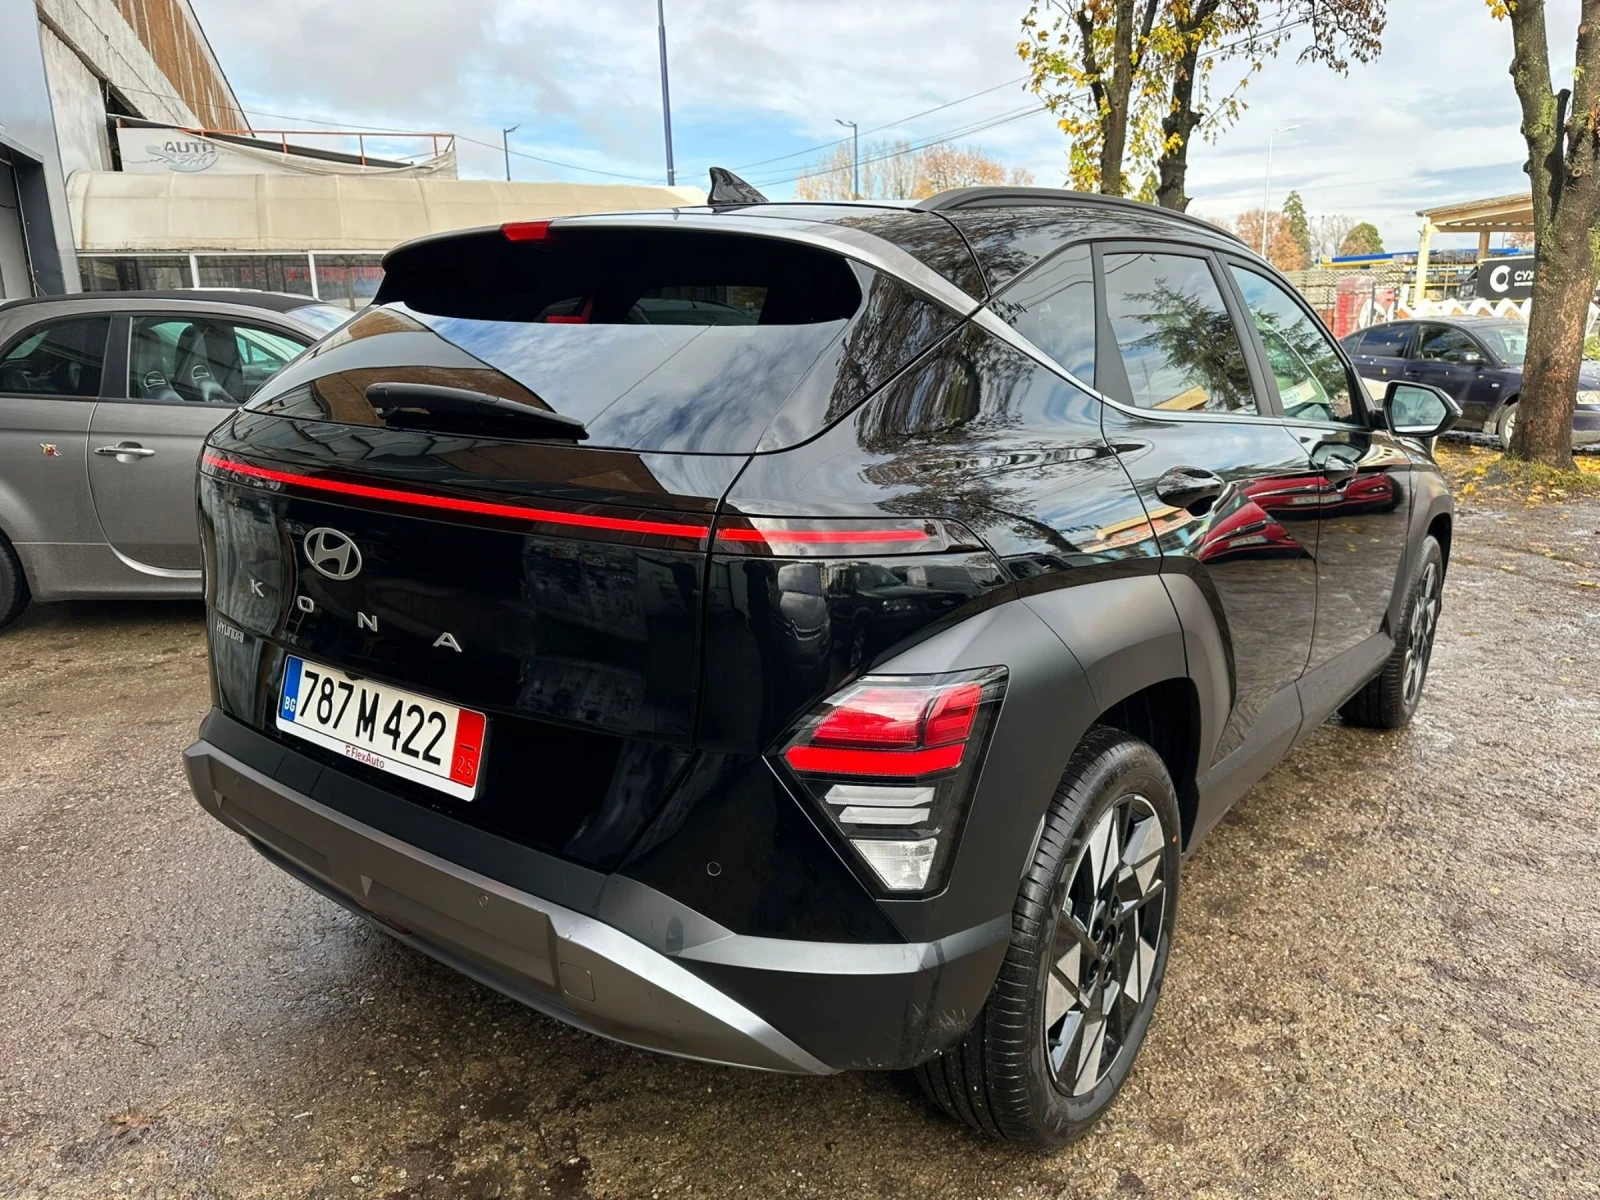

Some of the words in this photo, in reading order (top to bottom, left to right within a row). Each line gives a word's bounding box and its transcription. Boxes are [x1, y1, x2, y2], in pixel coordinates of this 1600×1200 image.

[164, 141, 216, 154] AUTO
[250, 578, 462, 653] KONA
[216, 620, 244, 644] HYUNDAI
[284, 696, 296, 712] BG
[455, 755, 474, 777] 25
